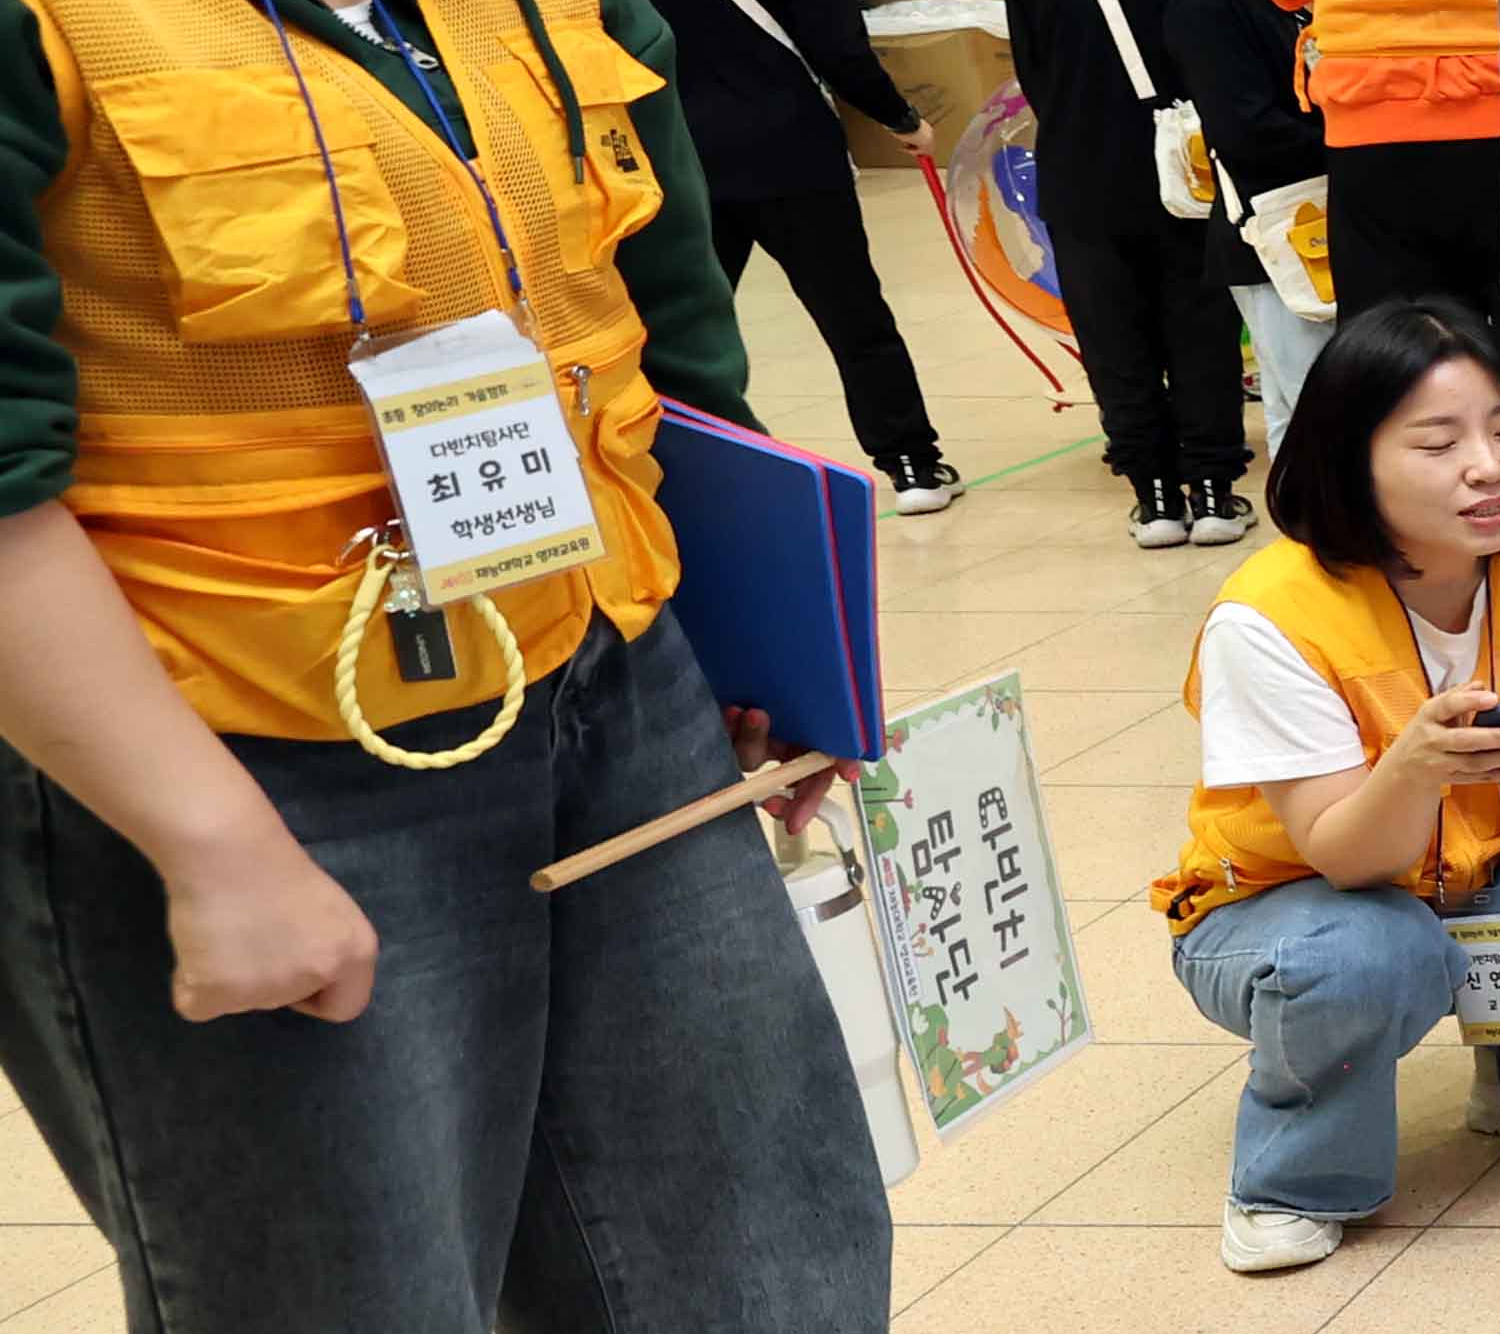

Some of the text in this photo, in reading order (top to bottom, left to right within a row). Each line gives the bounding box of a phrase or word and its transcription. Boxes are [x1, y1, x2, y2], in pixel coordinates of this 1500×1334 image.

[430, 422, 531, 458] 다빈치탐사단
[427, 448, 552, 503] 최 유 미
[451, 497, 557, 541] 학생선생님
[977, 785, 1030, 970] 다빈치
[911, 809, 980, 1006] 탐사단
[1466, 971, 1482, 990] 신
